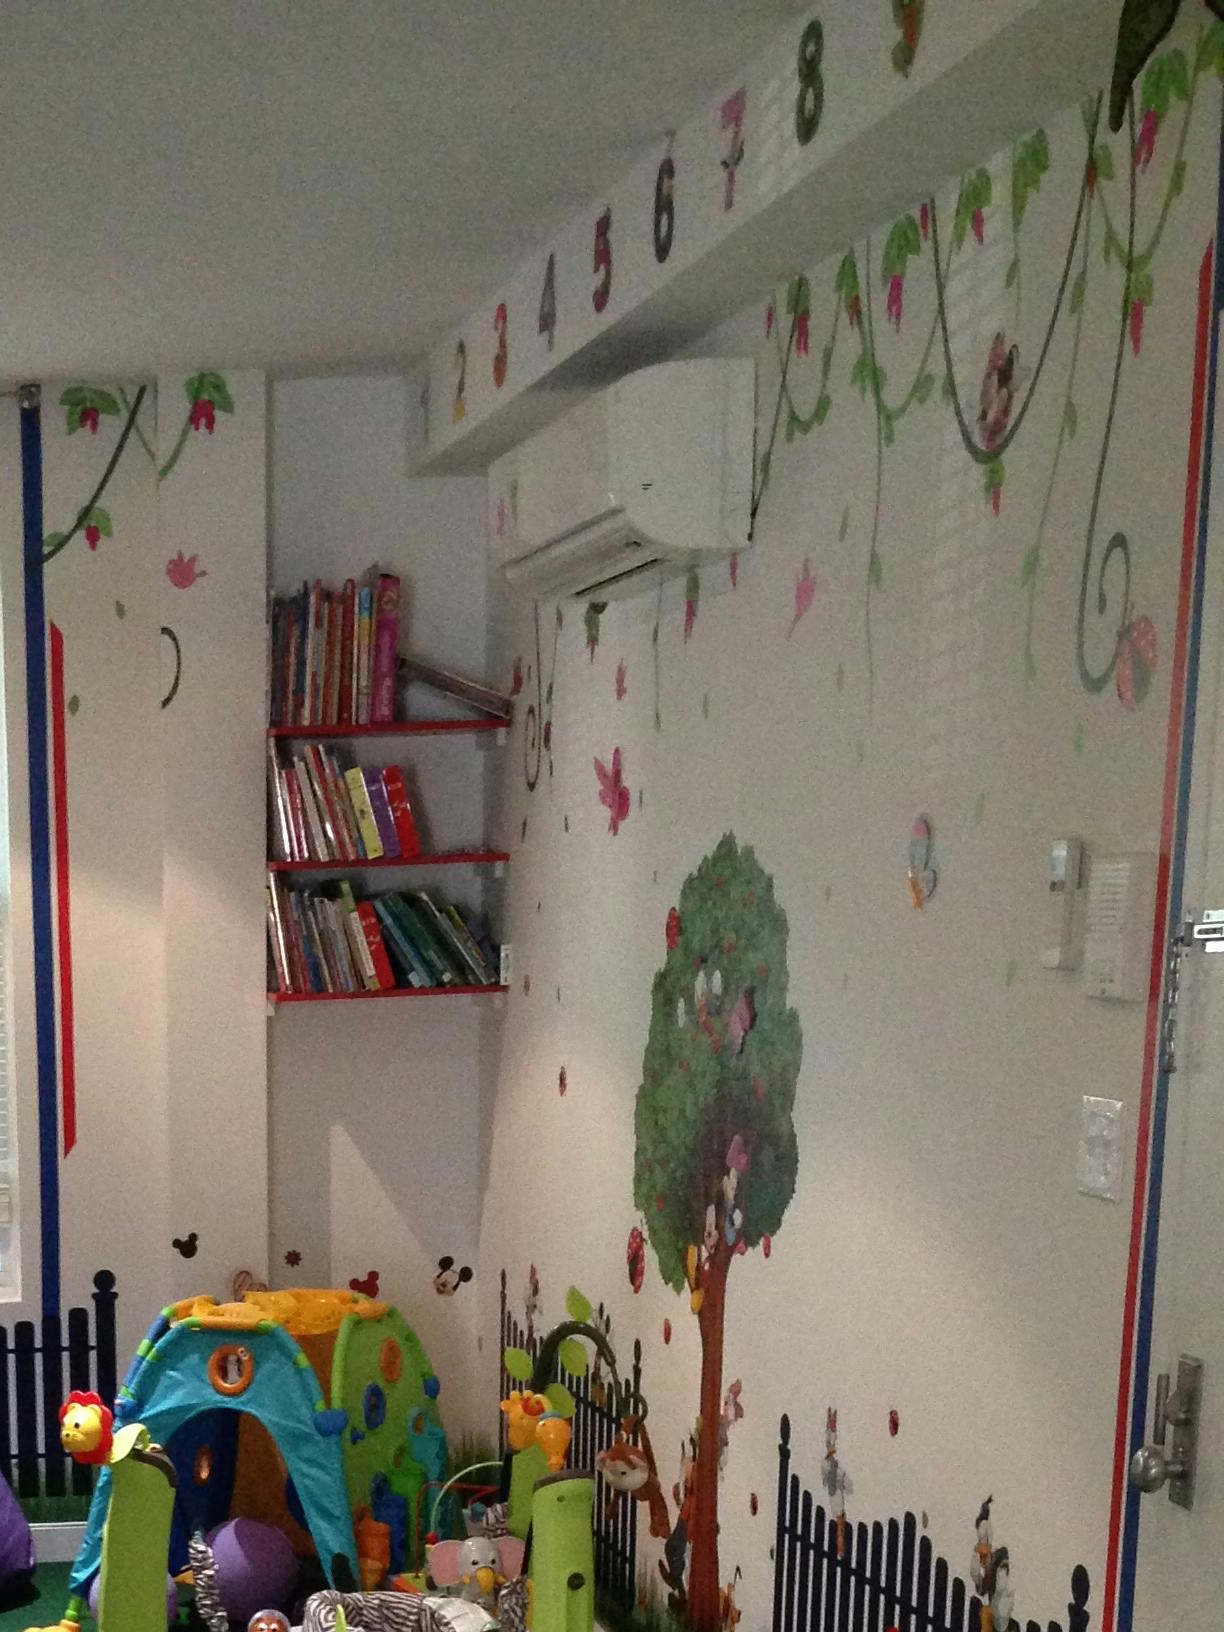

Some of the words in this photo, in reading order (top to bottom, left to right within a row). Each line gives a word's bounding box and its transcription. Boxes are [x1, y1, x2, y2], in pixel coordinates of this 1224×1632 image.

[592, 207, 611, 313] 5
[653, 155, 674, 263] 6
[796, 18, 824, 146] 8
